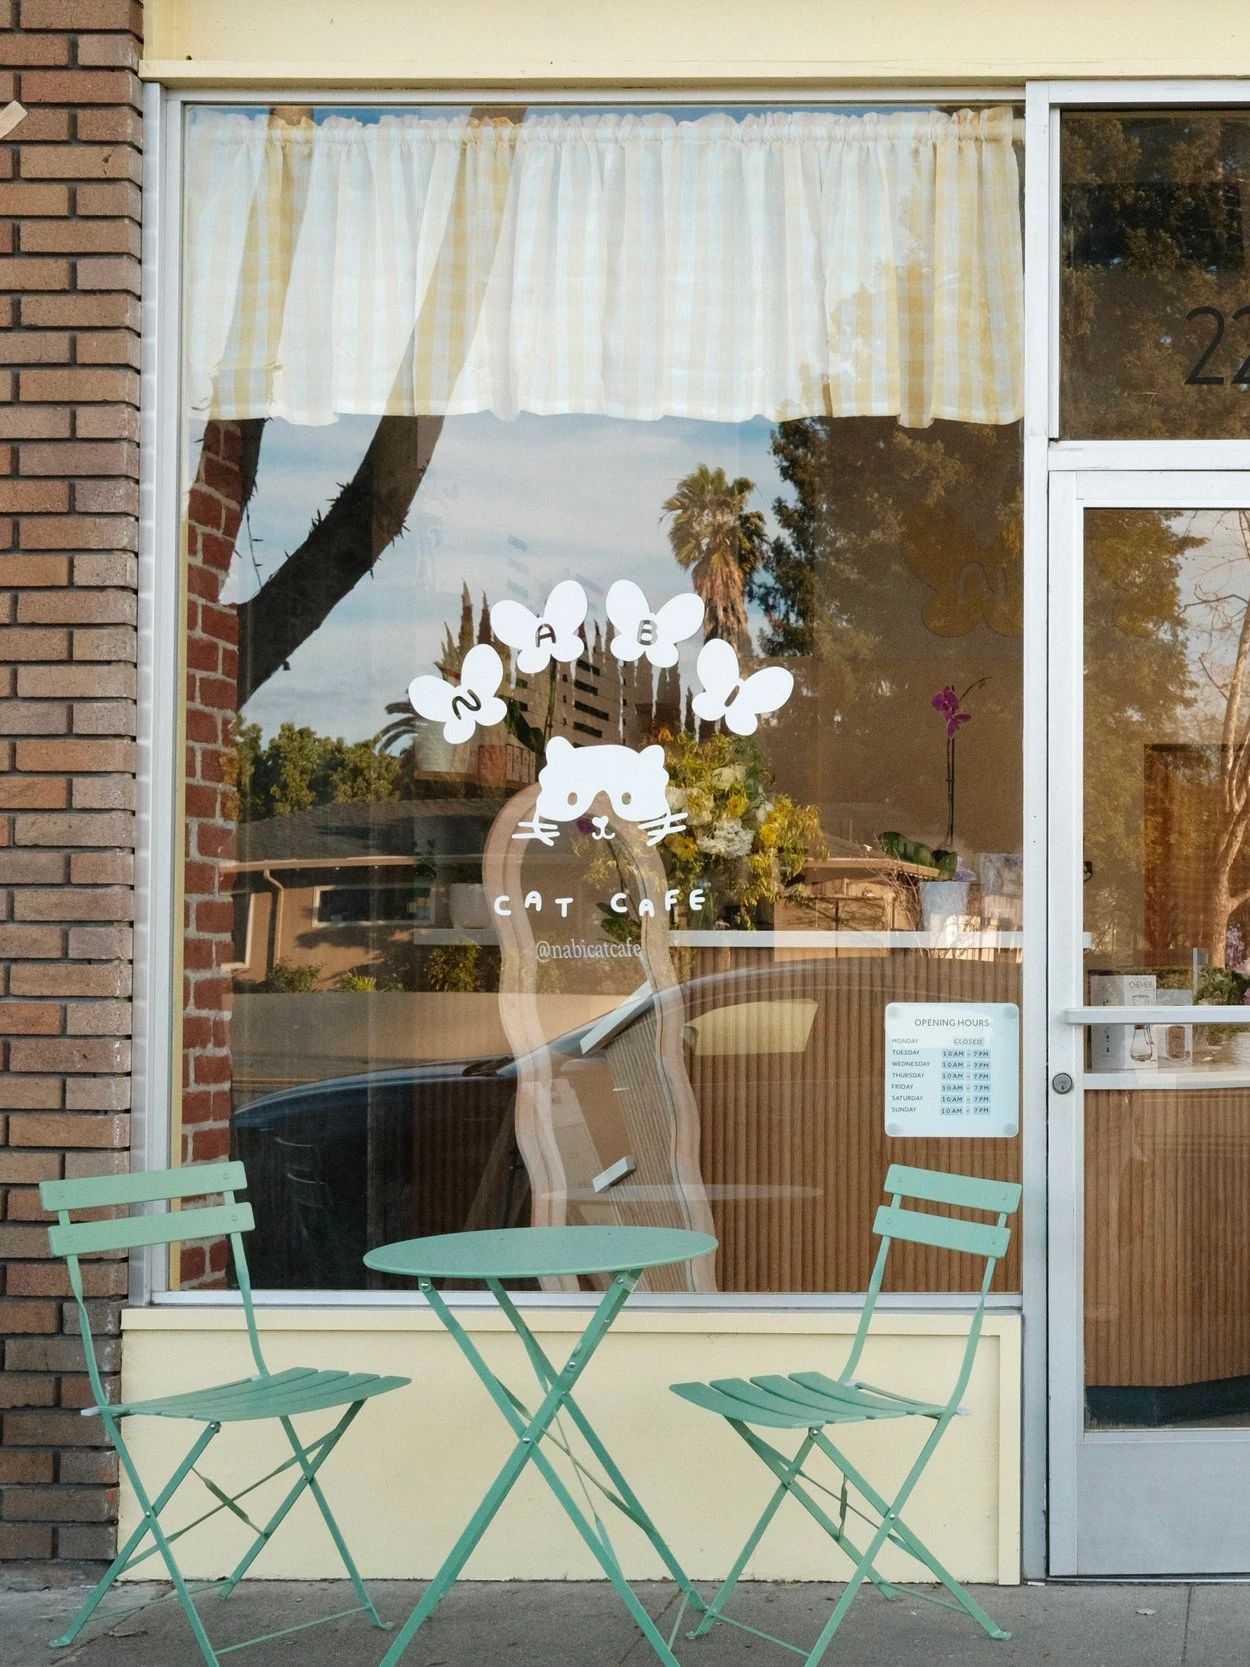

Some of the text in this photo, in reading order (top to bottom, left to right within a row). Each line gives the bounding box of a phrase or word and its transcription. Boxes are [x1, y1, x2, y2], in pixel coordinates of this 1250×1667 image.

[494, 888, 706, 918] CAT CAFE
[536, 937, 642, 964] @nabicatcafe
[914, 1018, 990, 1027] OPENING HOURS
